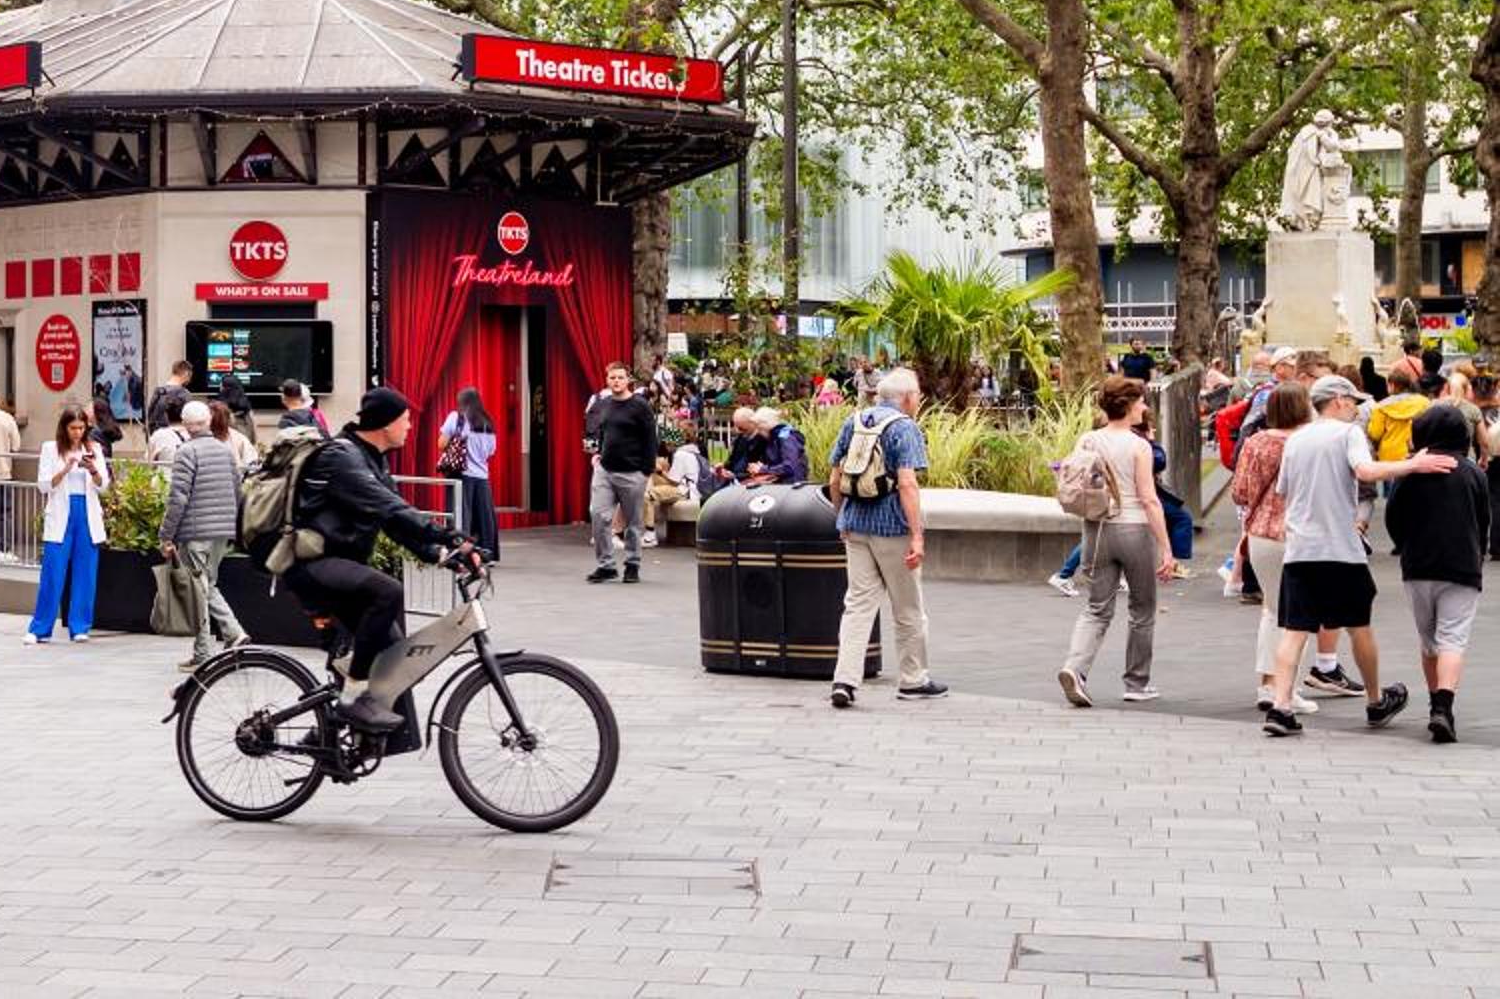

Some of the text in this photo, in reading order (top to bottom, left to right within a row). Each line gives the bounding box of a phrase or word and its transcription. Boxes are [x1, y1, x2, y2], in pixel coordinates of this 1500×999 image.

[516, 48, 605, 84] Theatre
[499, 226, 529, 240] TKTS
[232, 241, 286, 260] TKTS
[453, 253, 573, 287] Theatreland
[215, 286, 309, 297] WHAT'S ON SALE
